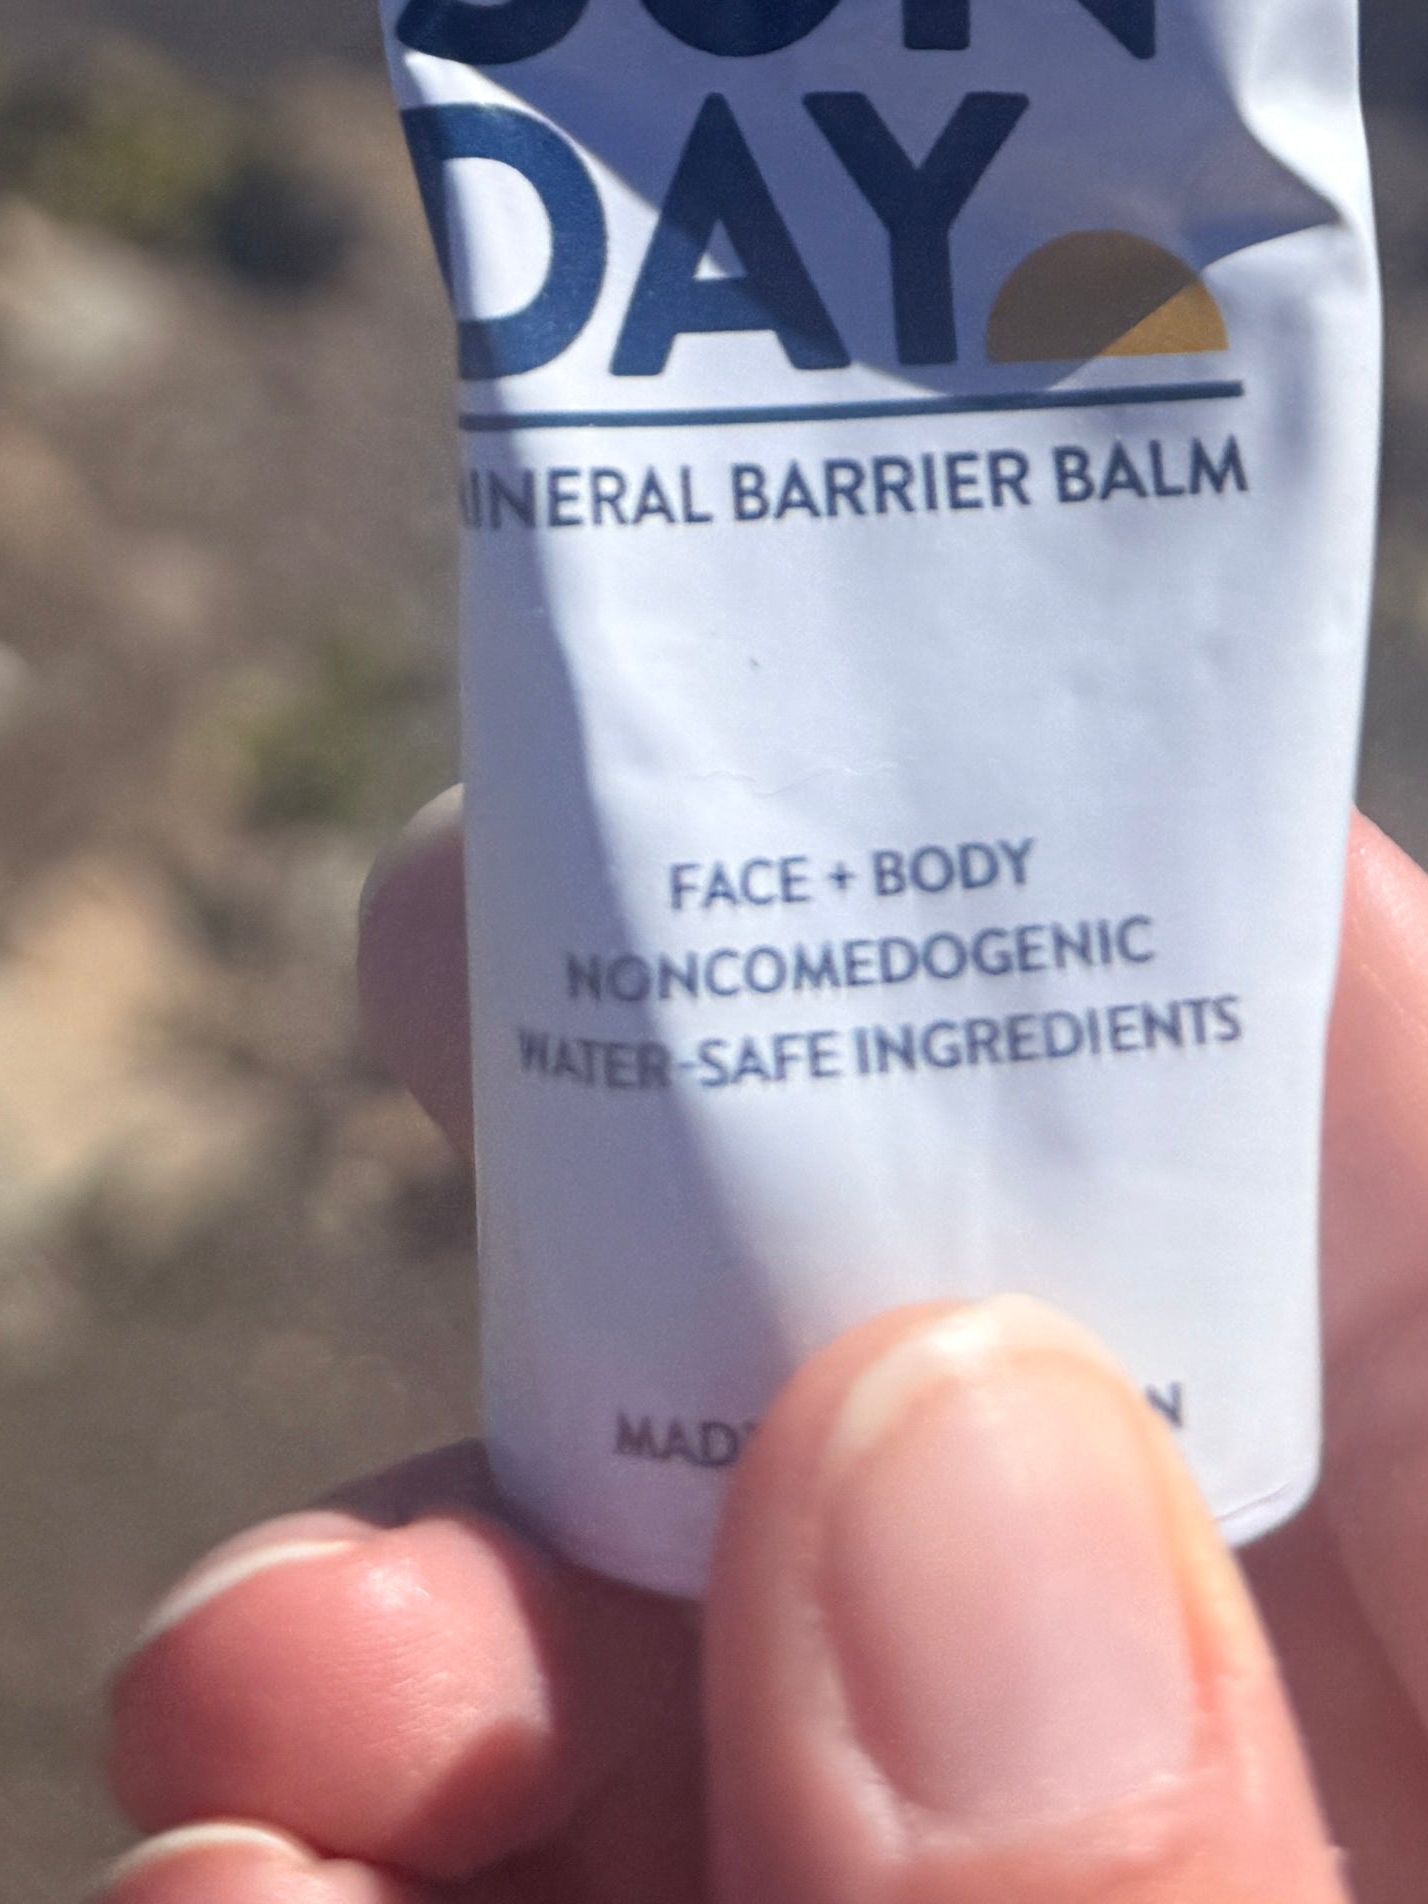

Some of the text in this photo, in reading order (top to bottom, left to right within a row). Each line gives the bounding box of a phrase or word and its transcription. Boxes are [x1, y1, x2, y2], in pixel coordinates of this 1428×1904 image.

[401, 92, 1030, 380] DAY
[461, 436, 1249, 530] INERAL BARRIER BALM
[671, 854, 809, 911] FACE
[874, 838, 1036, 896] BODY
[565, 915, 1156, 1005] NONCOMEDOGENIC
[518, 994, 1243, 1092] WATER-SAFE INGREDIENTS
[615, 1410, 760, 1468] MAD
